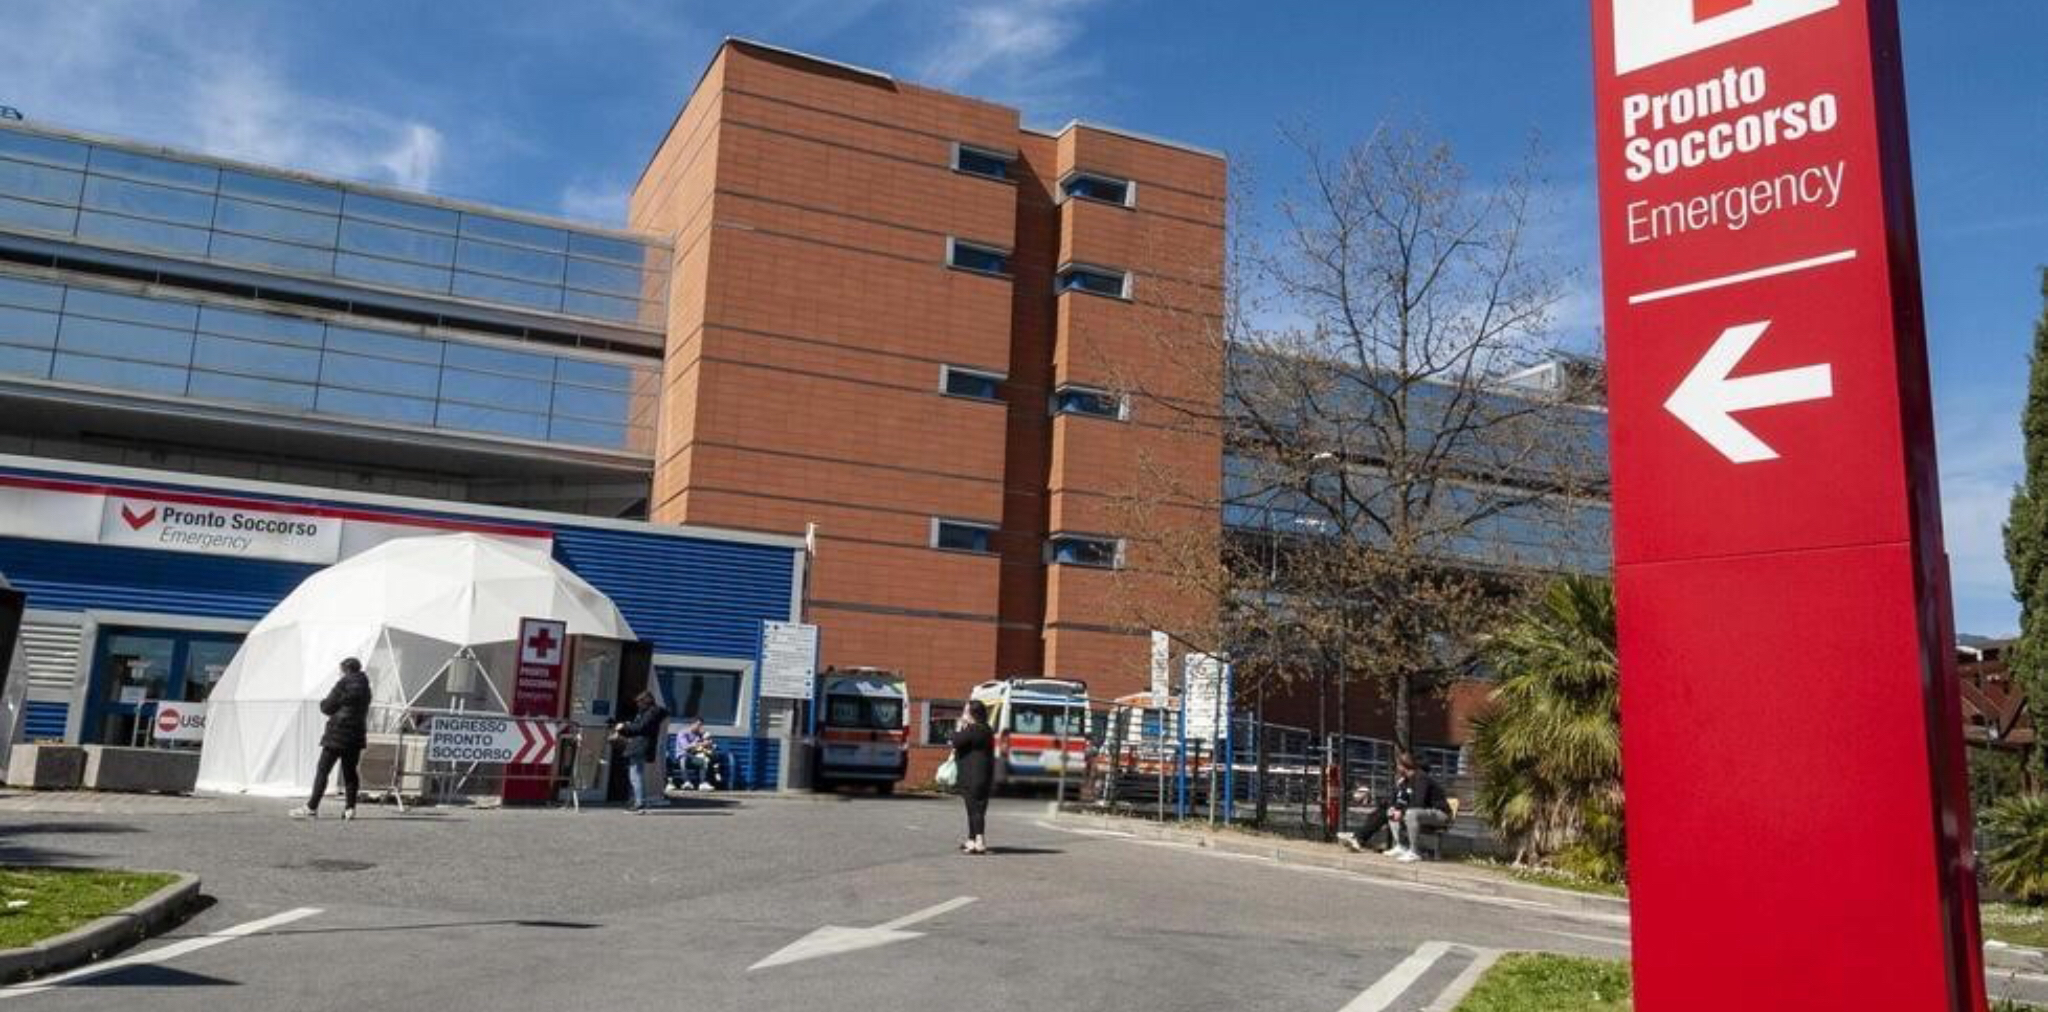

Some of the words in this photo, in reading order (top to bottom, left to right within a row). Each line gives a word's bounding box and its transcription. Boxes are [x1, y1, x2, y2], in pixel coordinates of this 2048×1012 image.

[1622, 65, 1767, 139] Pronto
[1624, 92, 1838, 183] Soccorso
[1626, 160, 1845, 245] Emergency
[162, 506, 226, 529] Pronto
[231, 513, 318, 537] Soccorso
[159, 526, 253, 551] Emergency
[433, 732, 494, 747] PRONTO
[434, 719, 508, 733] INGRESSO
[432, 745, 512, 761] SOCCORSO
